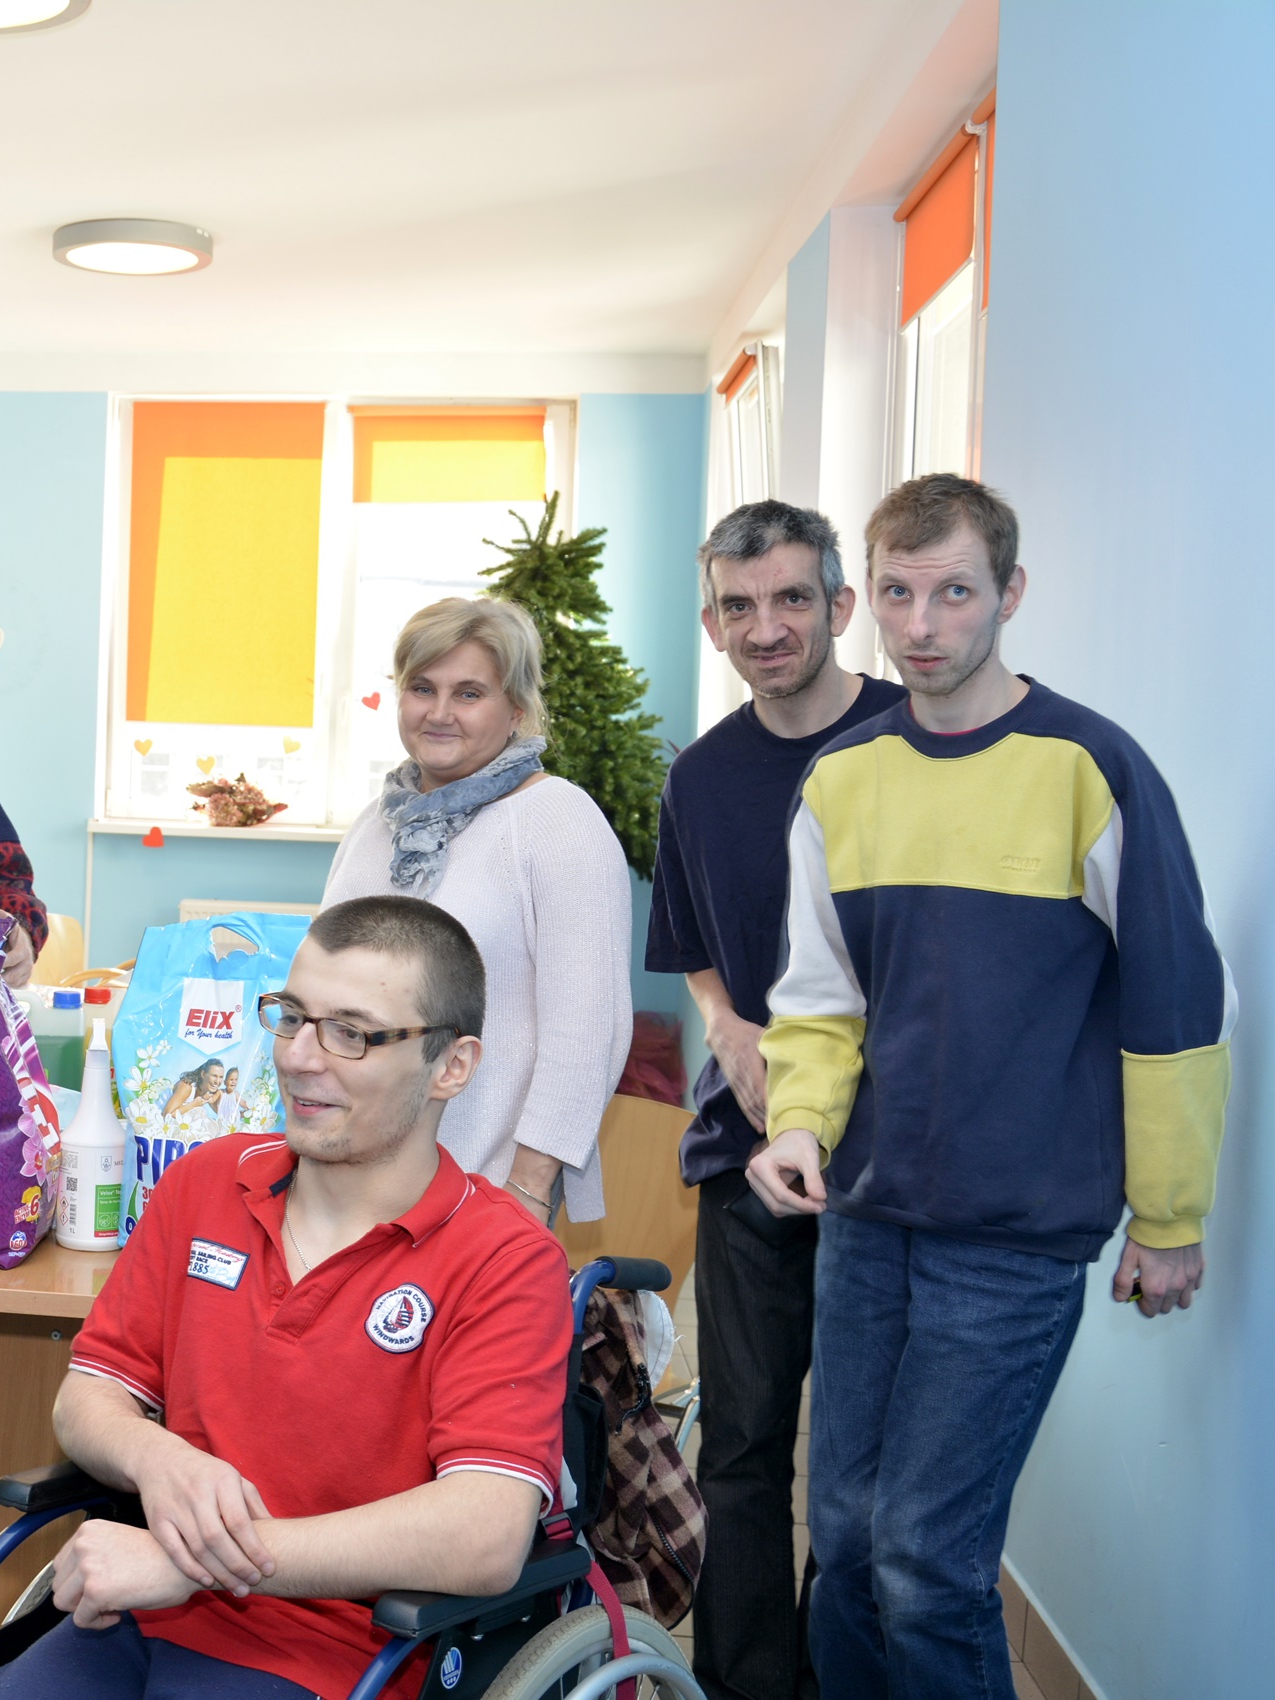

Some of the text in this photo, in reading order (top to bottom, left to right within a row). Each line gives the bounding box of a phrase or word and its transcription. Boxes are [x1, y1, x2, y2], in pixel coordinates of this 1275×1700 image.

[184, 1028, 195, 1039] for
[30, 1194, 40, 1217] 6
[217, 1256, 232, 1265] CLUB
[412, 1293, 428, 1323] COURSE
[373, 1323, 415, 1345] WINDWARDS
